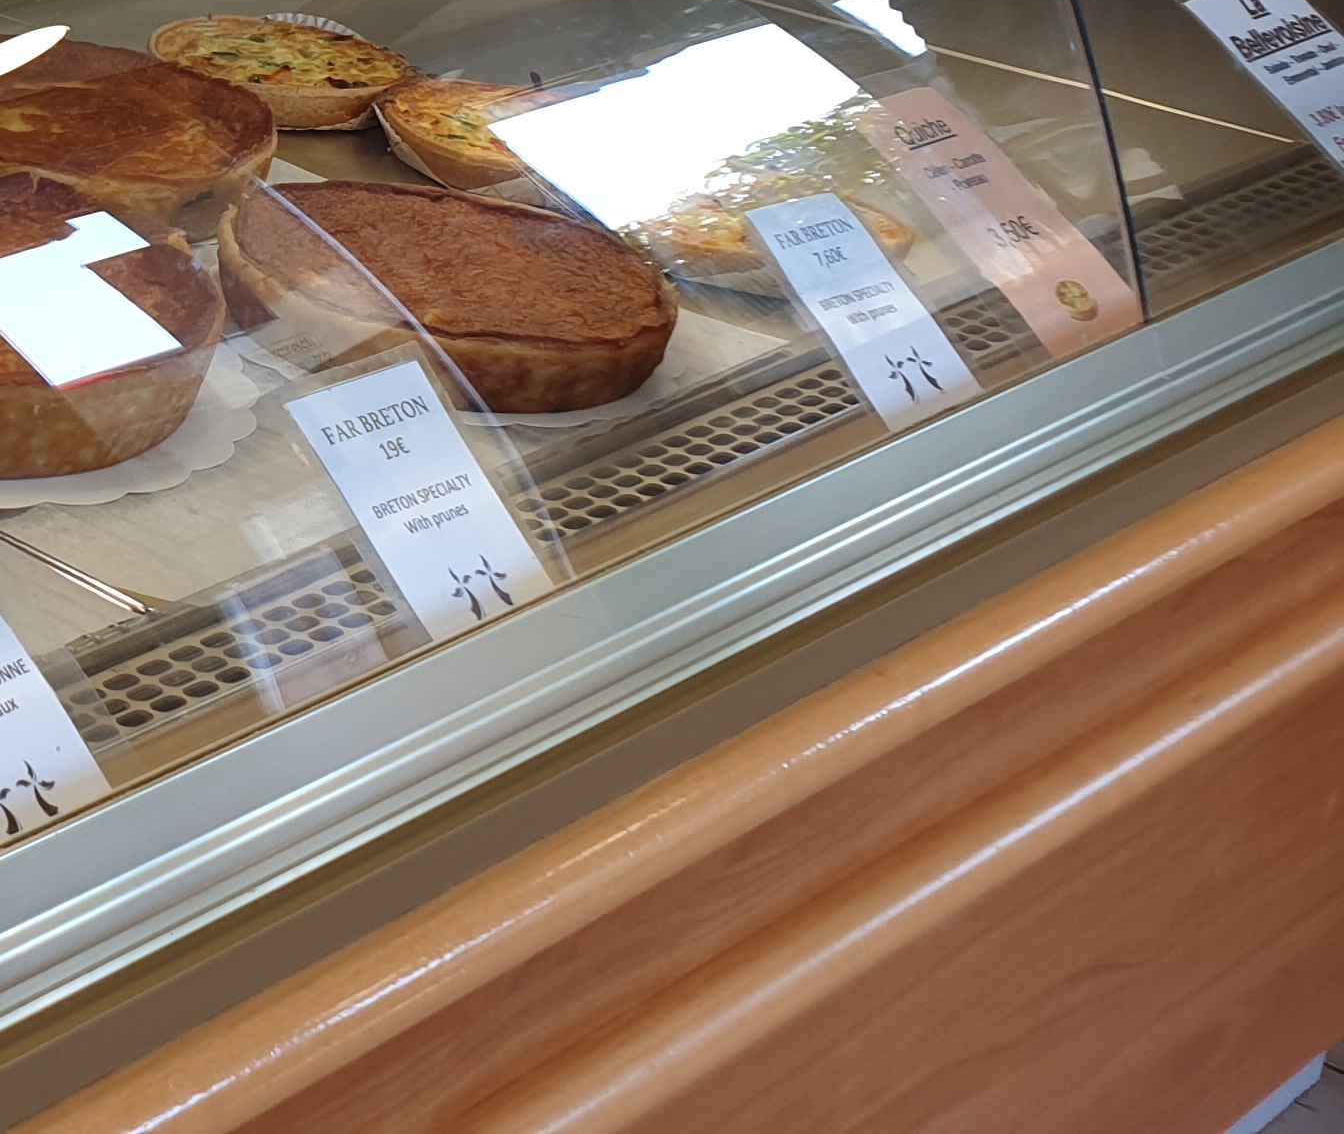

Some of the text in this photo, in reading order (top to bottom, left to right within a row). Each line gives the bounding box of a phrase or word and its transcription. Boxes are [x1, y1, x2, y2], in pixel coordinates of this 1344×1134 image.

[894, 118, 952, 146] Quiche
[773, 217, 854, 249] FAR BRETON
[987, 216, 1040, 248] 3,50€
[818, 281, 895, 311] BRETON SPECIALTY
[321, 395, 430, 446] FAR BRETON
[378, 436, 410, 461] 19€
[371, 492, 419, 520] BRETON
[419, 473, 472, 504] SPECIALTY
[403, 503, 469, 535] With prunes
